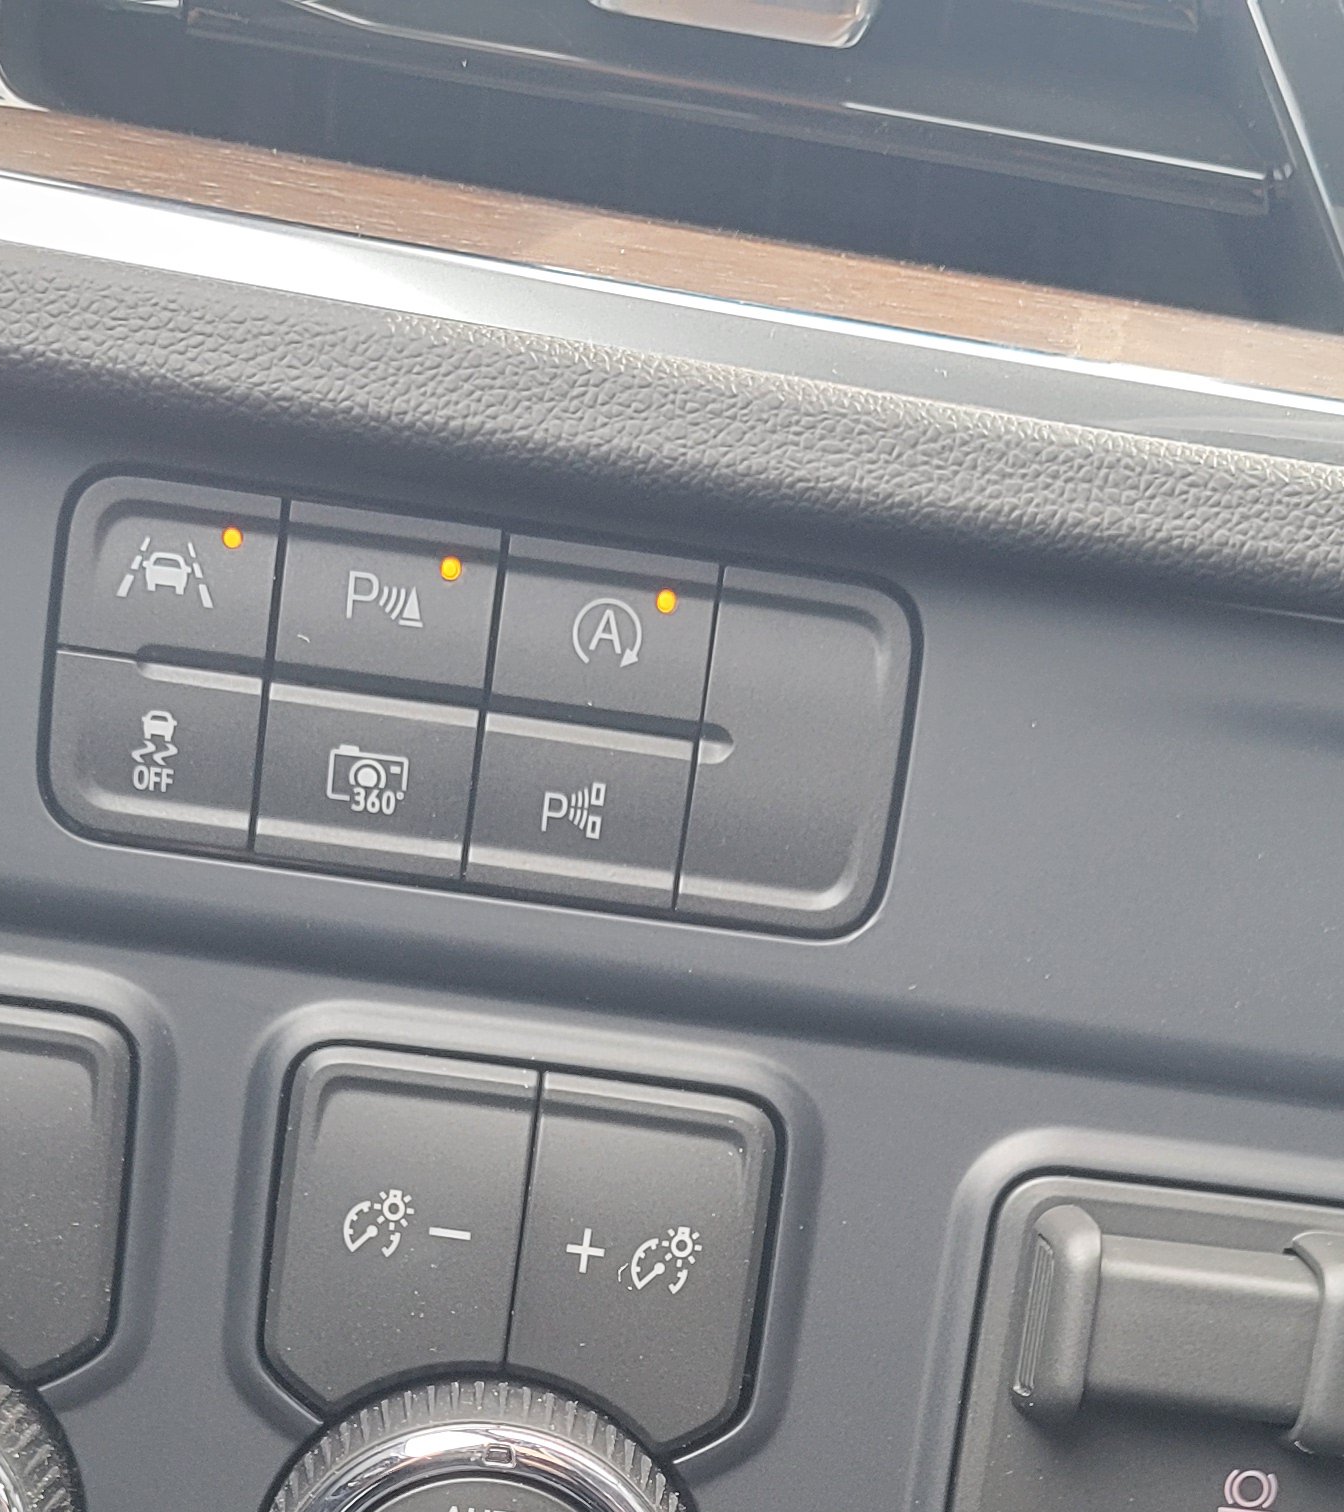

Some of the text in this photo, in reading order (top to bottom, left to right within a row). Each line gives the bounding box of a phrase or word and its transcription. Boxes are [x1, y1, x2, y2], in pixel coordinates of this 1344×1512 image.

[346, 570, 379, 620] P
[588, 607, 622, 654] A
[132, 764, 174, 793] OFF
[541, 791, 569, 832] P
